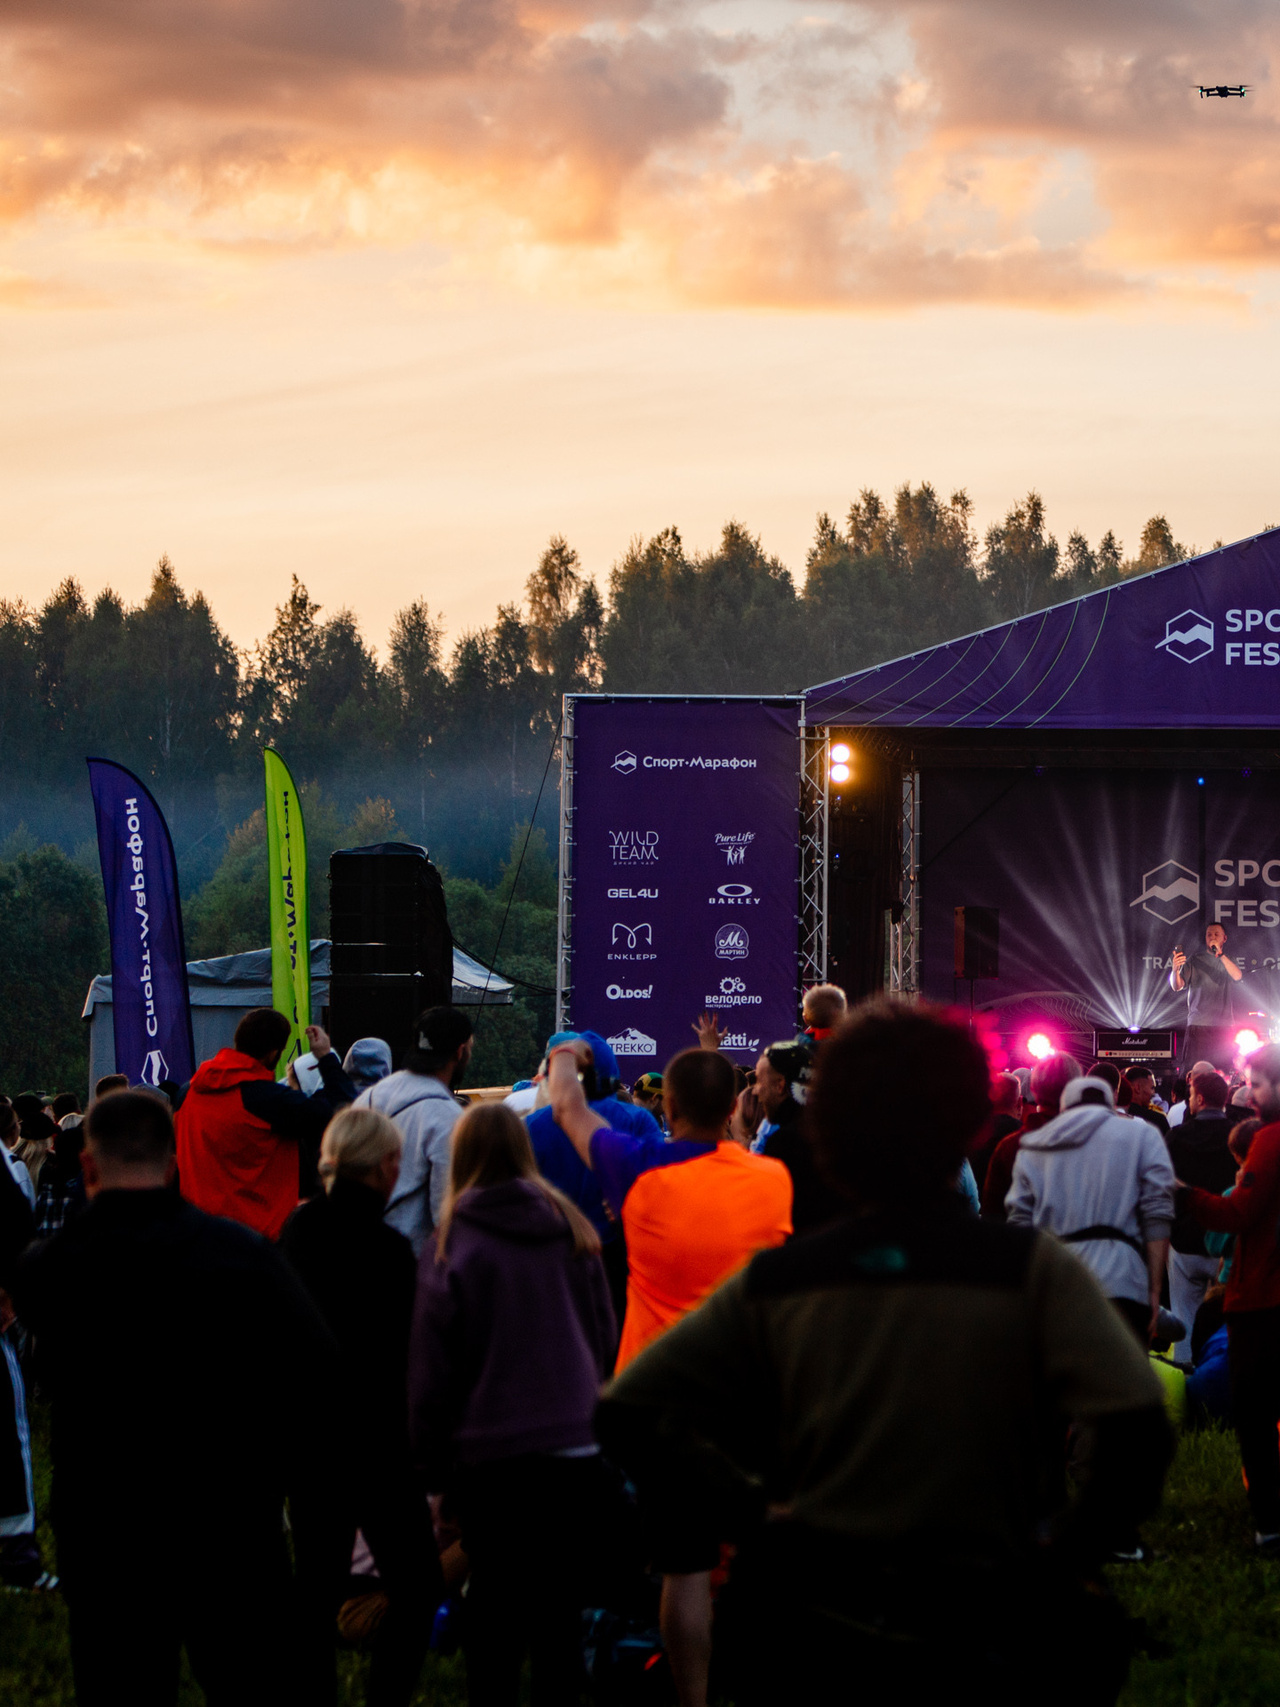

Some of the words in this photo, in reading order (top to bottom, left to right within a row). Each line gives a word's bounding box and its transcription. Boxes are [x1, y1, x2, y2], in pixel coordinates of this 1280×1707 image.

[608, 830, 660, 846] WILD
[714, 832, 737, 844] Pure
[737, 831, 755, 842] Life
[608, 845, 659, 861] TEAM
[607, 888, 659, 899] GEL4U
[708, 897, 761, 905] OAKLEY
[607, 953, 658, 961] ENKLEPP
[610, 1043, 652, 1053] TREKKO
